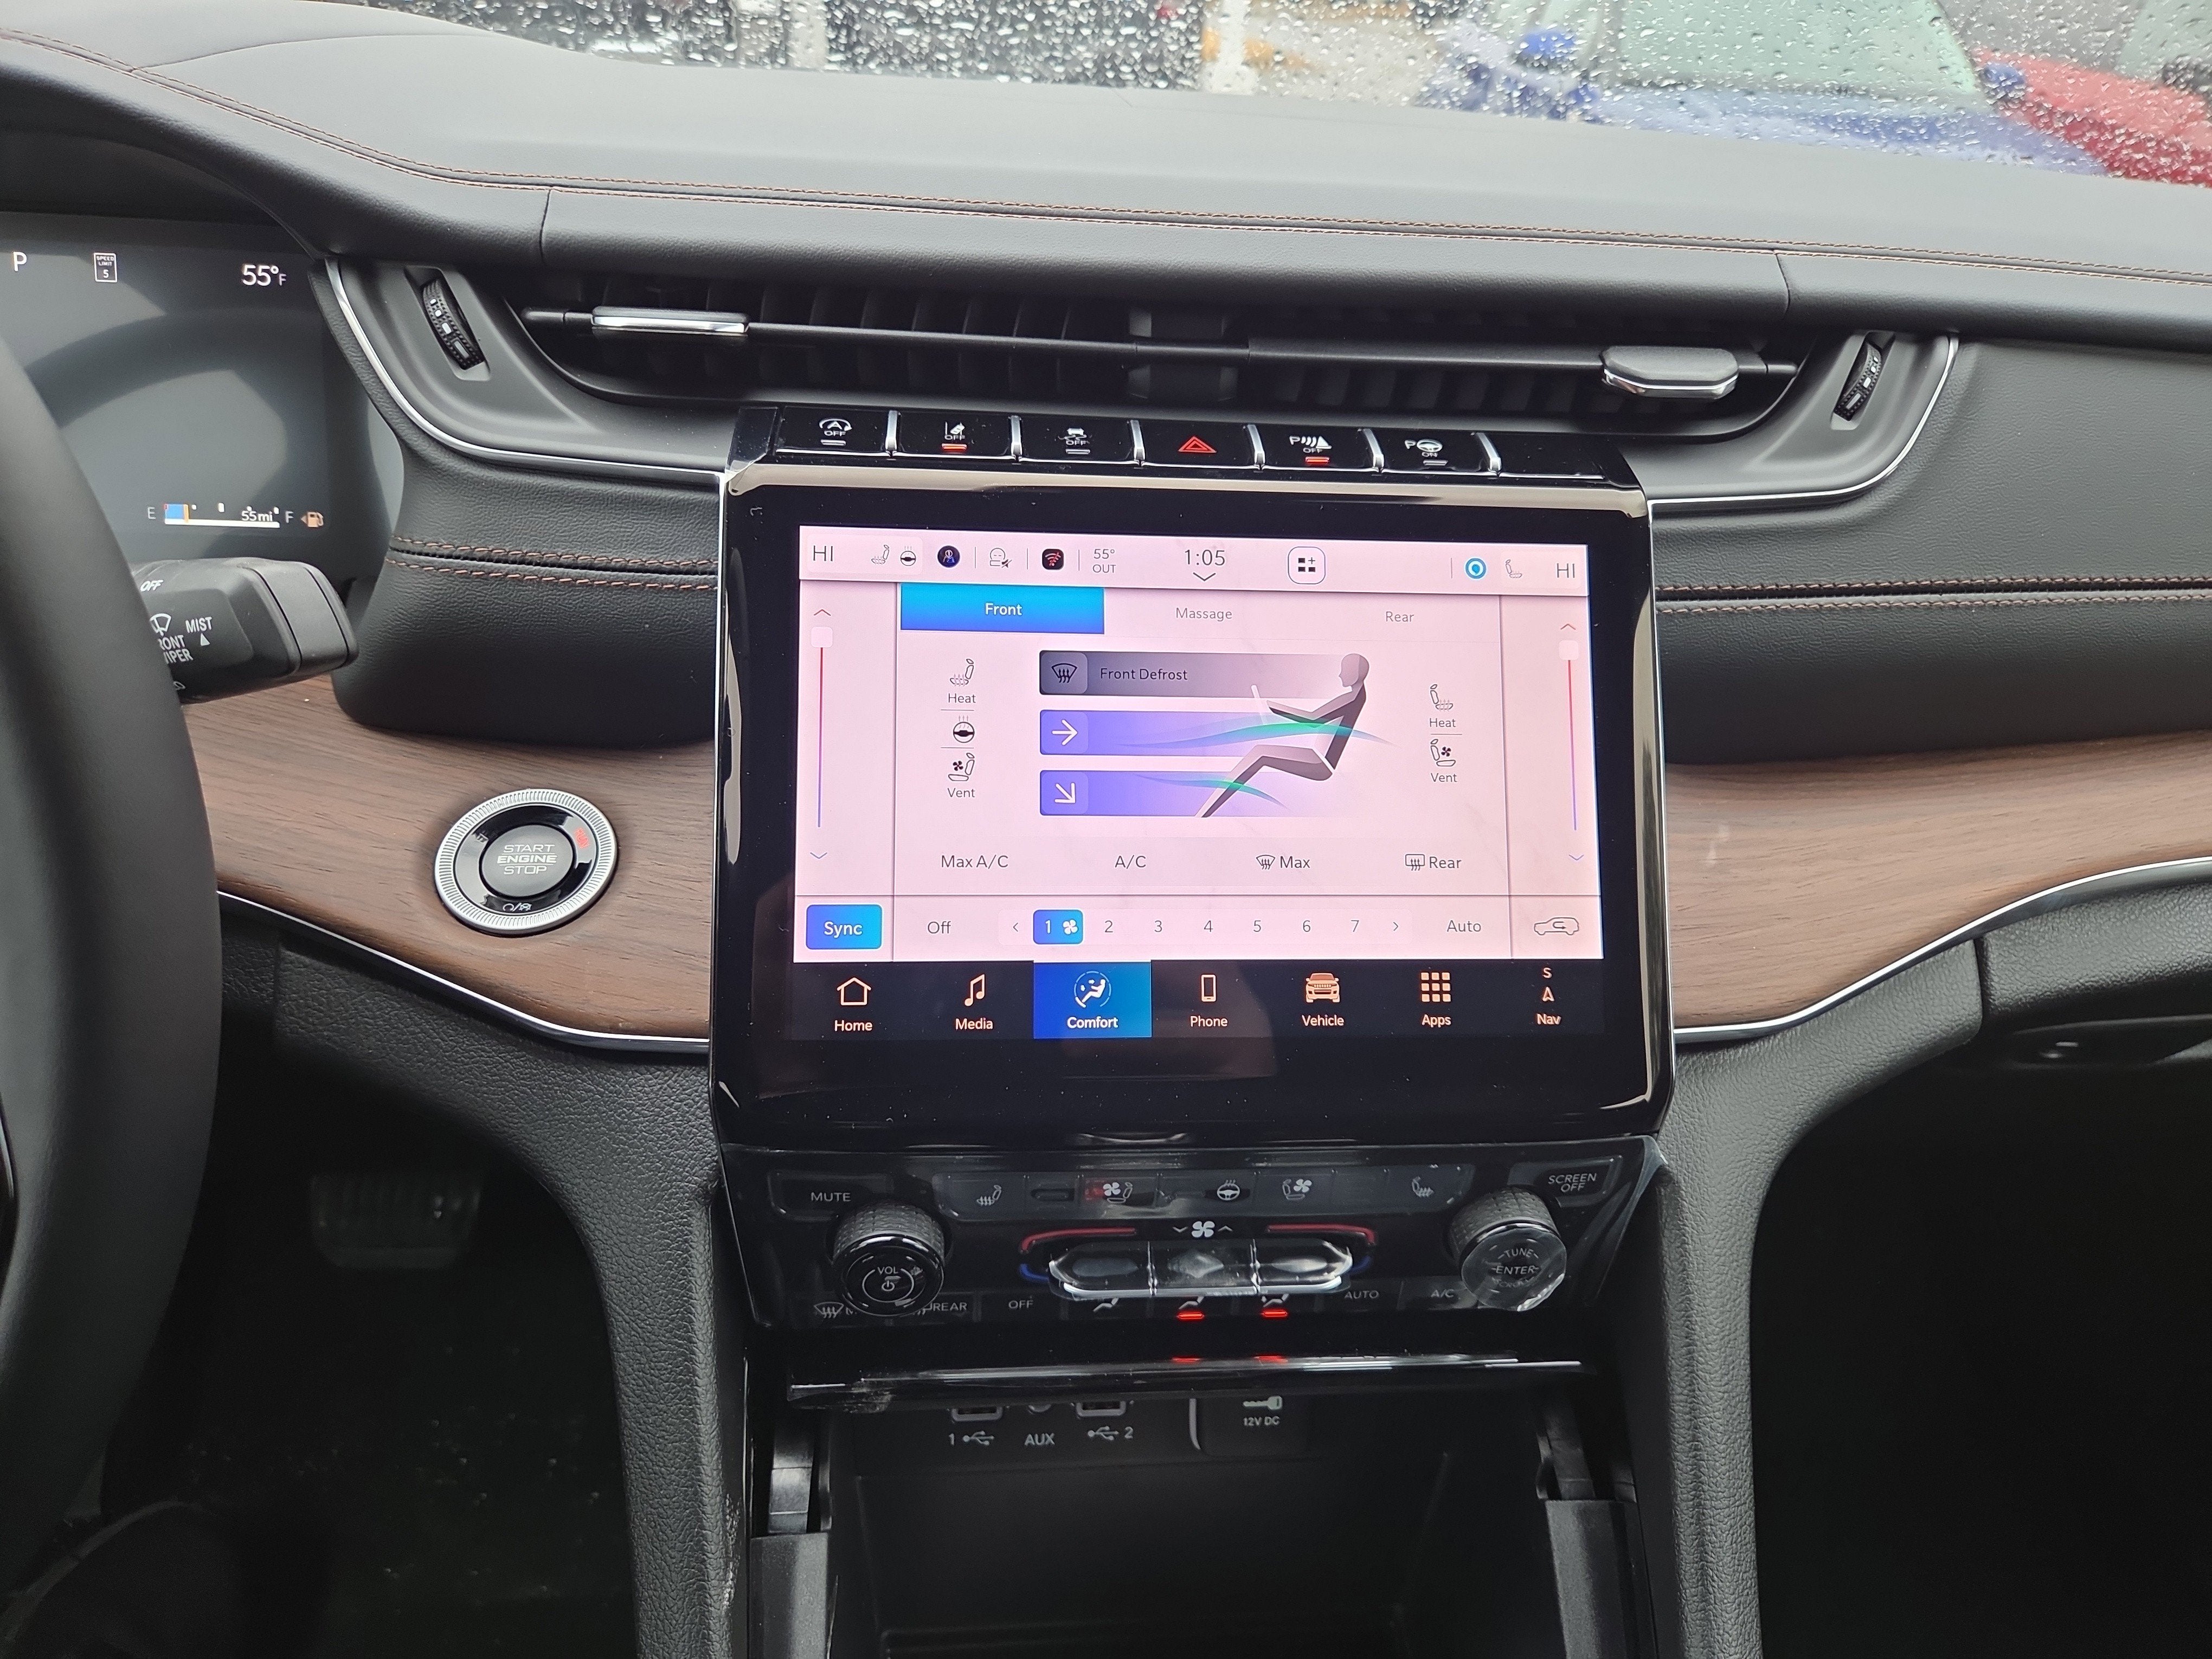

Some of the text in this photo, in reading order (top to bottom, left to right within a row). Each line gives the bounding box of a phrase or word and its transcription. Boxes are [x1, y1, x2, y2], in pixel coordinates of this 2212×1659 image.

[13, 251, 27, 272] P
[147, 507, 156, 519] E
[285, 511, 294, 523] F
[813, 545, 834, 562] HI
[1094, 548, 1115, 561] 55°
[1184, 549, 1226, 567] 1:05
[1092, 564, 1116, 574] OUT
[1557, 563, 1575, 578] HI
[140, 580, 163, 591] OFF
[985, 602, 1023, 616] Front
[1176, 607, 1233, 622] Massage
[1386, 611, 1414, 623] Rear
[185, 616, 213, 633] MIST
[163, 648, 194, 664] IPER
[1100, 668, 1188, 681] Front Defrost
[948, 693, 976, 704] Heat
[1429, 718, 1456, 728] Heat
[1430, 773, 1457, 783] Vent
[947, 788, 975, 798] Vent
[503, 844, 555, 853] START
[497, 855, 557, 863] ENGINE
[941, 854, 1008, 869] Max A/C
[1115, 854, 1147, 869] A/C
[1280, 856, 1310, 869] Max
[1429, 856, 1462, 869] Rear
[503, 866, 547, 875] STOP
[824, 921, 863, 938] Sync
[927, 921, 951, 934] Off
[1045, 920, 1051, 934] 1
[1104, 920, 1114, 934] 2
[1154, 920, 1163, 933] 3
[1204, 920, 1213, 933] 4
[1253, 920, 1262, 933] 5
[1302, 920, 1311, 933] 6
[1351, 920, 1359, 933] 7
[1446, 919, 1481, 933] Auto
[1542, 968, 1552, 979] S
[834, 1019, 872, 1031] Home
[955, 1018, 993, 1030] Media
[1067, 1017, 1118, 1029] Comfort
[1191, 1015, 1227, 1027] Phone
[1302, 1015, 1344, 1027] Vehicle
[1422, 1014, 1451, 1028] Apps
[1537, 1013, 1561, 1026] Nav
[1548, 1173, 1597, 1185] SCREEN
[1560, 1182, 1585, 1192] OFF
[811, 1192, 851, 1203] MUTE
[1504, 1248, 1534, 1258] TUNE
[877, 1266, 898, 1275] VOL
[1496, 1265, 1535, 1275] ENTER
[1344, 1290, 1379, 1299] AUTO
[1431, 1289, 1454, 1298] A/C
[933, 1302, 967, 1311] REAR
[1008, 1300, 1033, 1310] OFF
[1244, 1416, 1280, 1426] 12V DC
[949, 1433, 955, 1445] 1
[1025, 1433, 1054, 1445] AUX
[1124, 1427, 1134, 1439] 2
